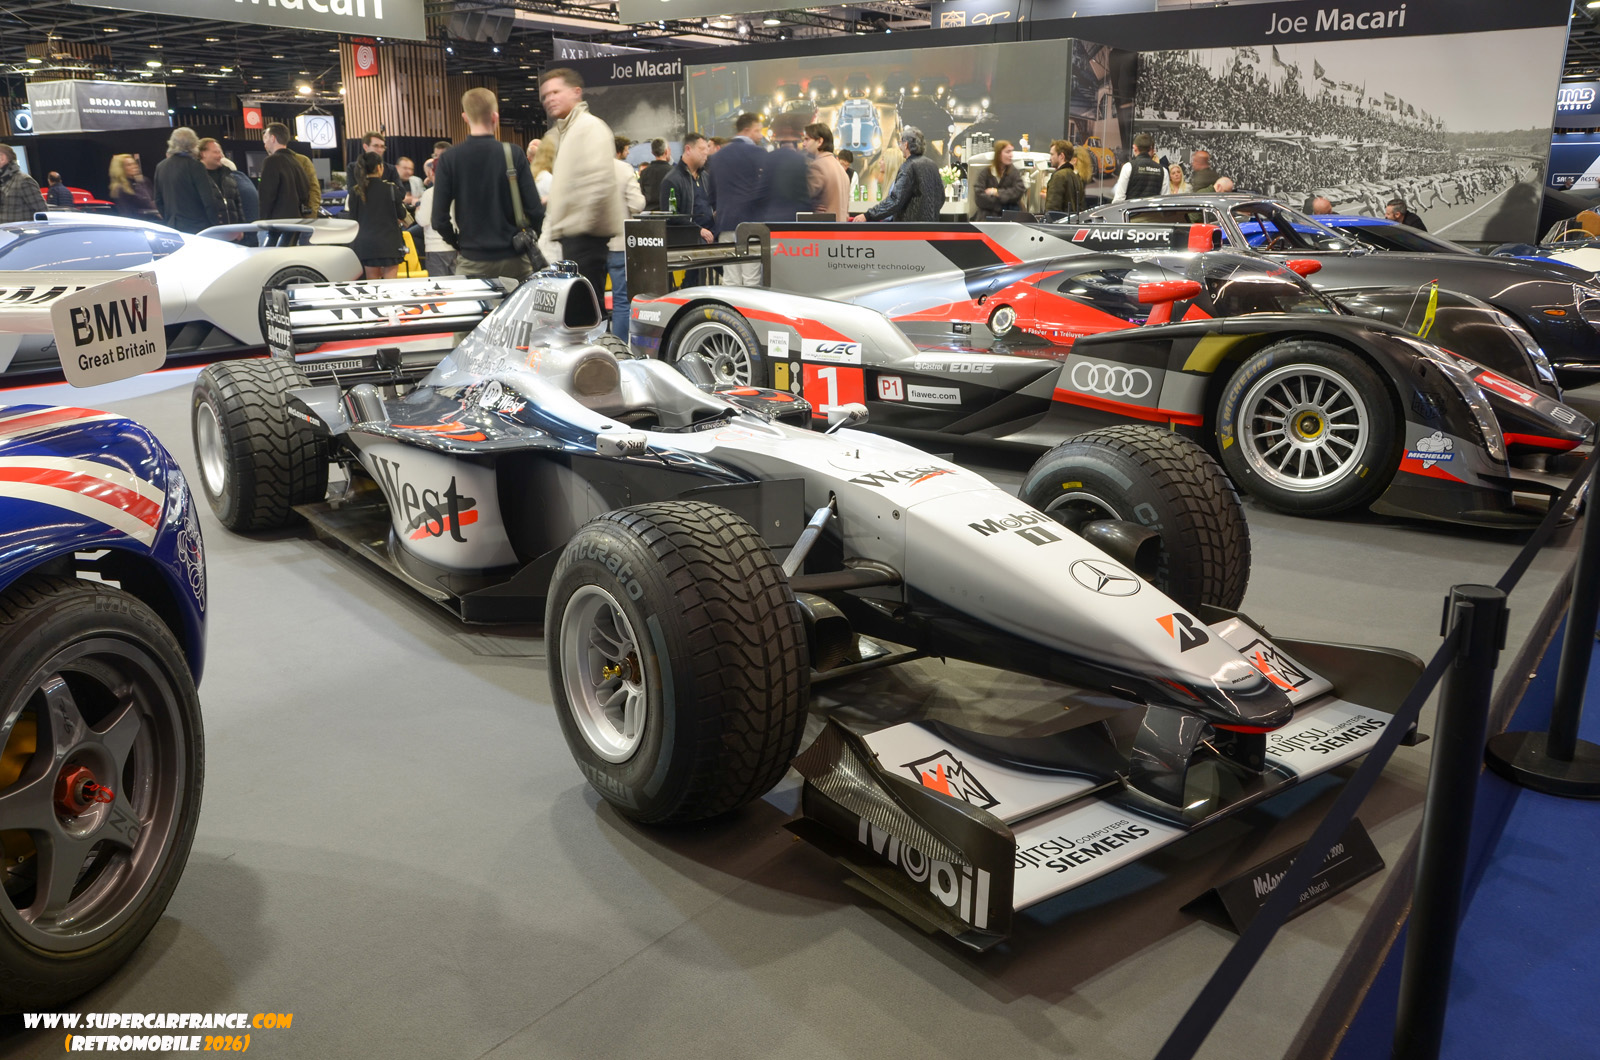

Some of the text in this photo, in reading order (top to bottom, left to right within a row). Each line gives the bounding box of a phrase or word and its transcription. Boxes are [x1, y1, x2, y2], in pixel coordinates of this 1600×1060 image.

[1265, 4, 1407, 35] Joe Macari
[610, 58, 681, 79] Joe Macari
[35, 99, 52, 108] BROAD
[89, 98, 157, 108] BROAD ARROW
[637, 237, 664, 247] BOSCH
[1090, 229, 1170, 243] Audi Sport
[773, 242, 875, 258] Audi ultra
[827, 262, 926, 272] lightweight technology
[534, 291, 557, 307] BOSS
[70, 295, 148, 347] BMW
[720, 312, 758, 357] MICHELIN
[78, 340, 156, 371] Great Britain
[816, 343, 857, 355] WEC
[300, 360, 362, 372] RIDGESTONE
[921, 362, 995, 373] Castrol EDGE
[817, 367, 839, 414] 1
[881, 379, 899, 396] P1
[911, 390, 957, 400] fiawec.com
[1223, 357, 1268, 422] MICHELIN
[1482, 375, 1533, 401] 1
[497, 394, 527, 414] West
[701, 421, 727, 430] KENWOOD
[627, 440, 645, 450] Sun
[1407, 452, 1453, 460] MICHELIN
[848, 465, 957, 488] West
[369, 453, 467, 543] West
[968, 510, 1053, 537] Mobil
[1265, 714, 1367, 757] FUJITSU COMPUTERS
[1309, 718, 1387, 755] SIEMENS
[1015, 820, 1130, 869] UJITSU COMPUTERS
[1045, 824, 1150, 874] SIEMENS
[1330, 843, 1345, 858] 2000
[857, 815, 991, 930] Mobil
[1308, 878, 1331, 896] Macari
